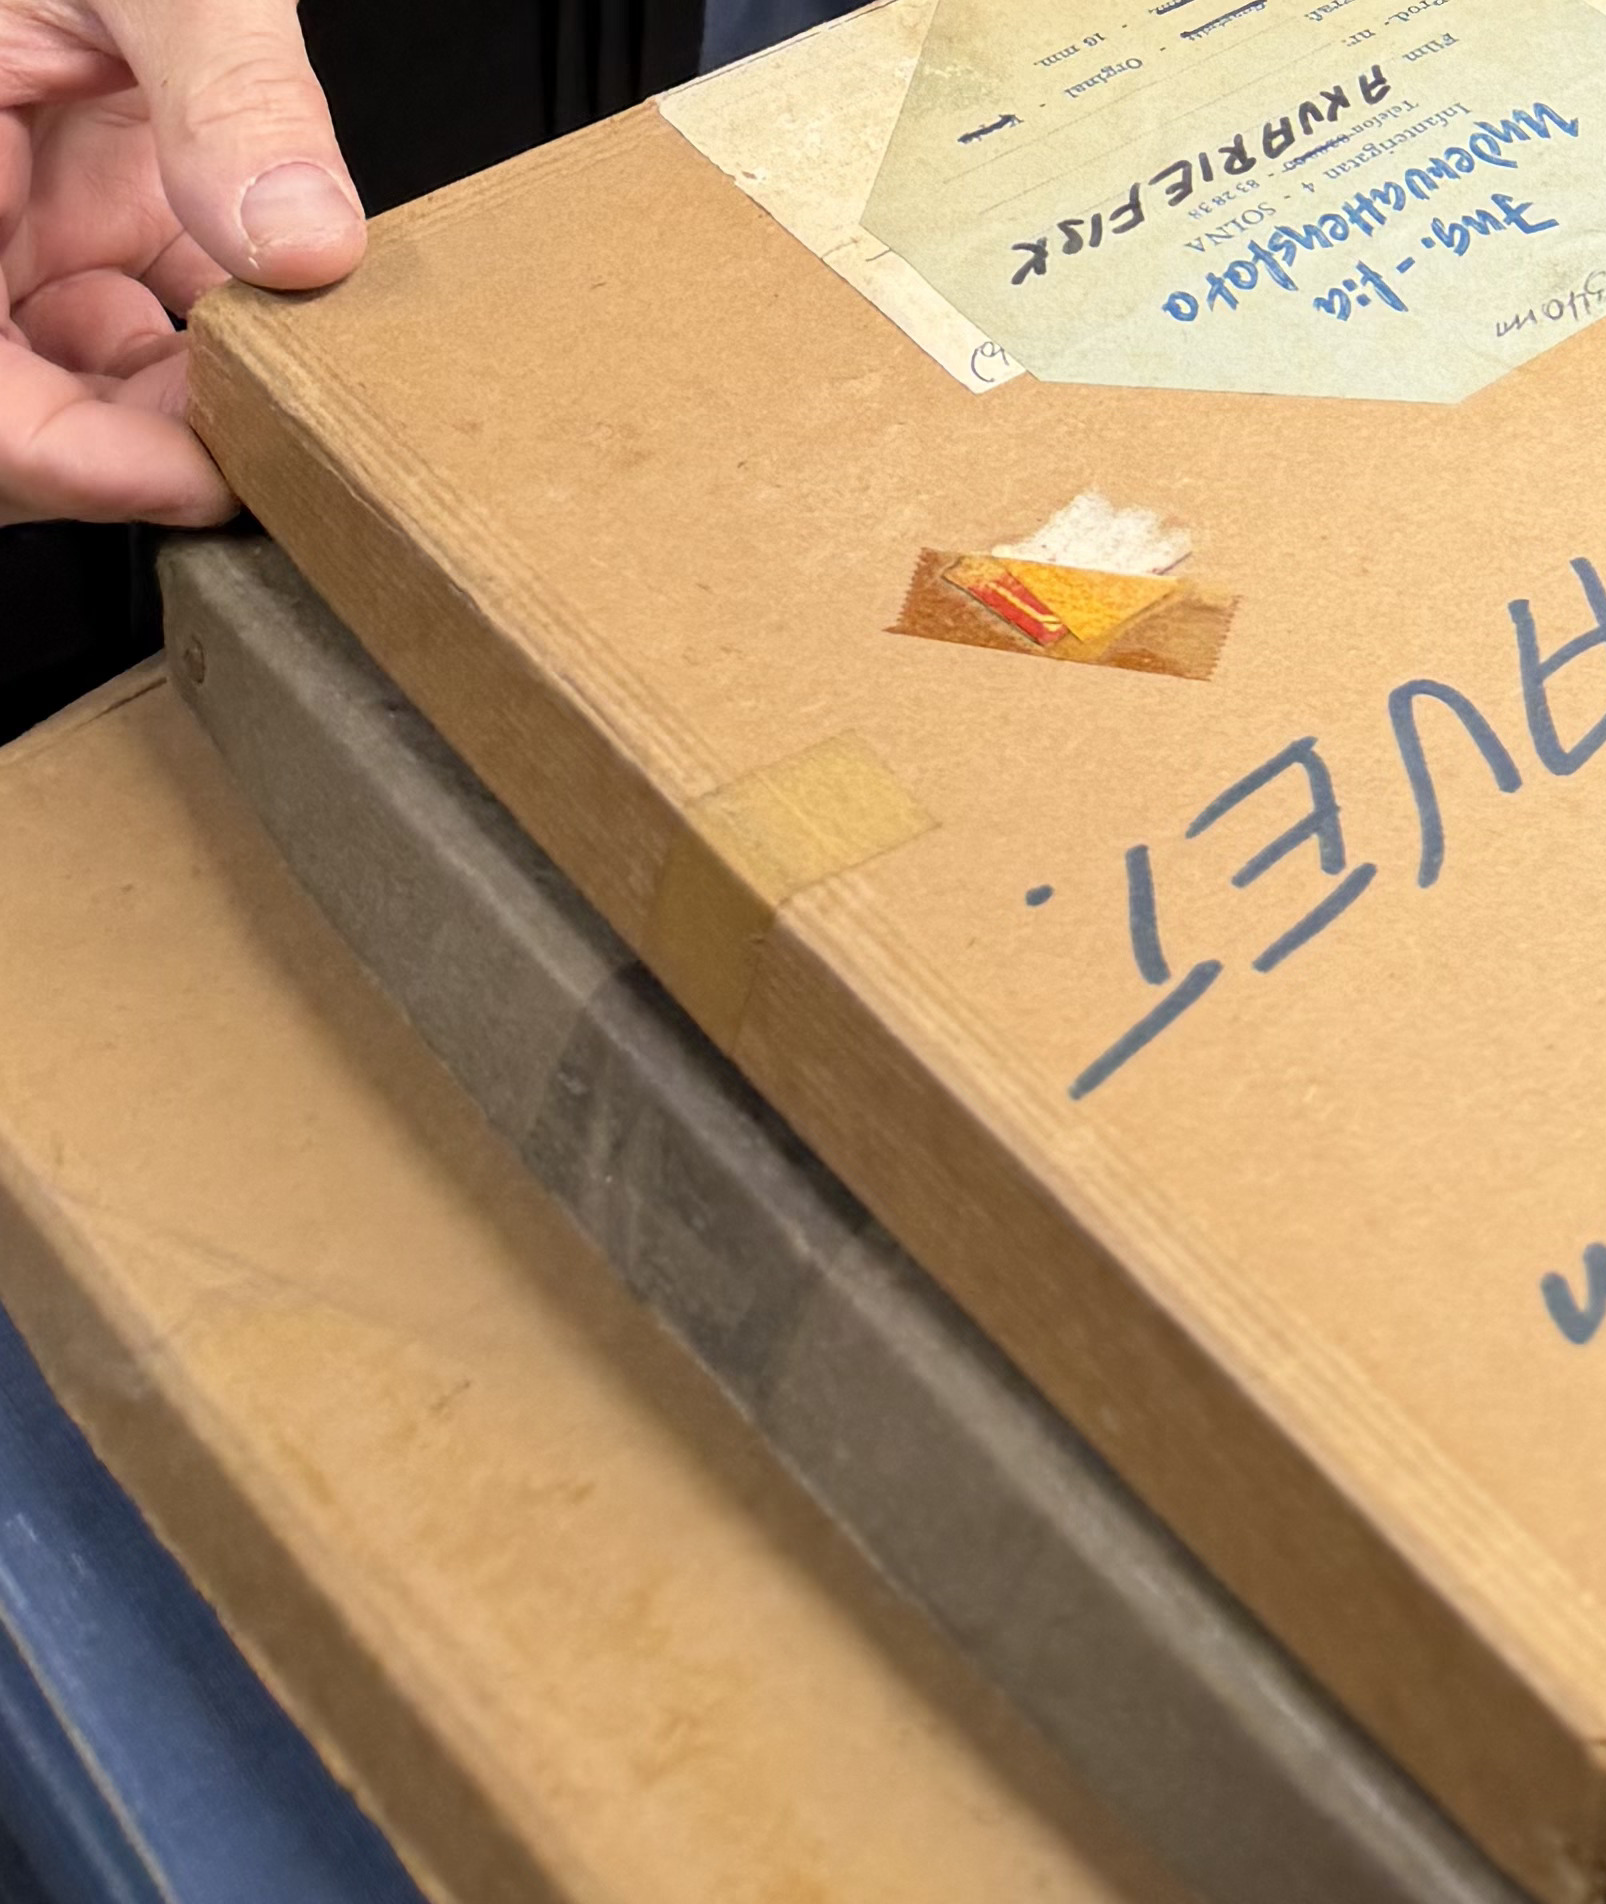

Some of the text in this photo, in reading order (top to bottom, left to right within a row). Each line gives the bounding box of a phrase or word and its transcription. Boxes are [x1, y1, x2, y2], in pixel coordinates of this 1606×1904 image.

[1033, 44, 1080, 67] mm.
[1063, 57, 1144, 98] Orginal
[1011, 32, 1459, 285] Film AKVARIEFISK
[1322, 102, 1474, 180] Infanterigatan
[1301, 181, 1316, 194] 4
[1184, 202, 1277, 255] SOLNA
